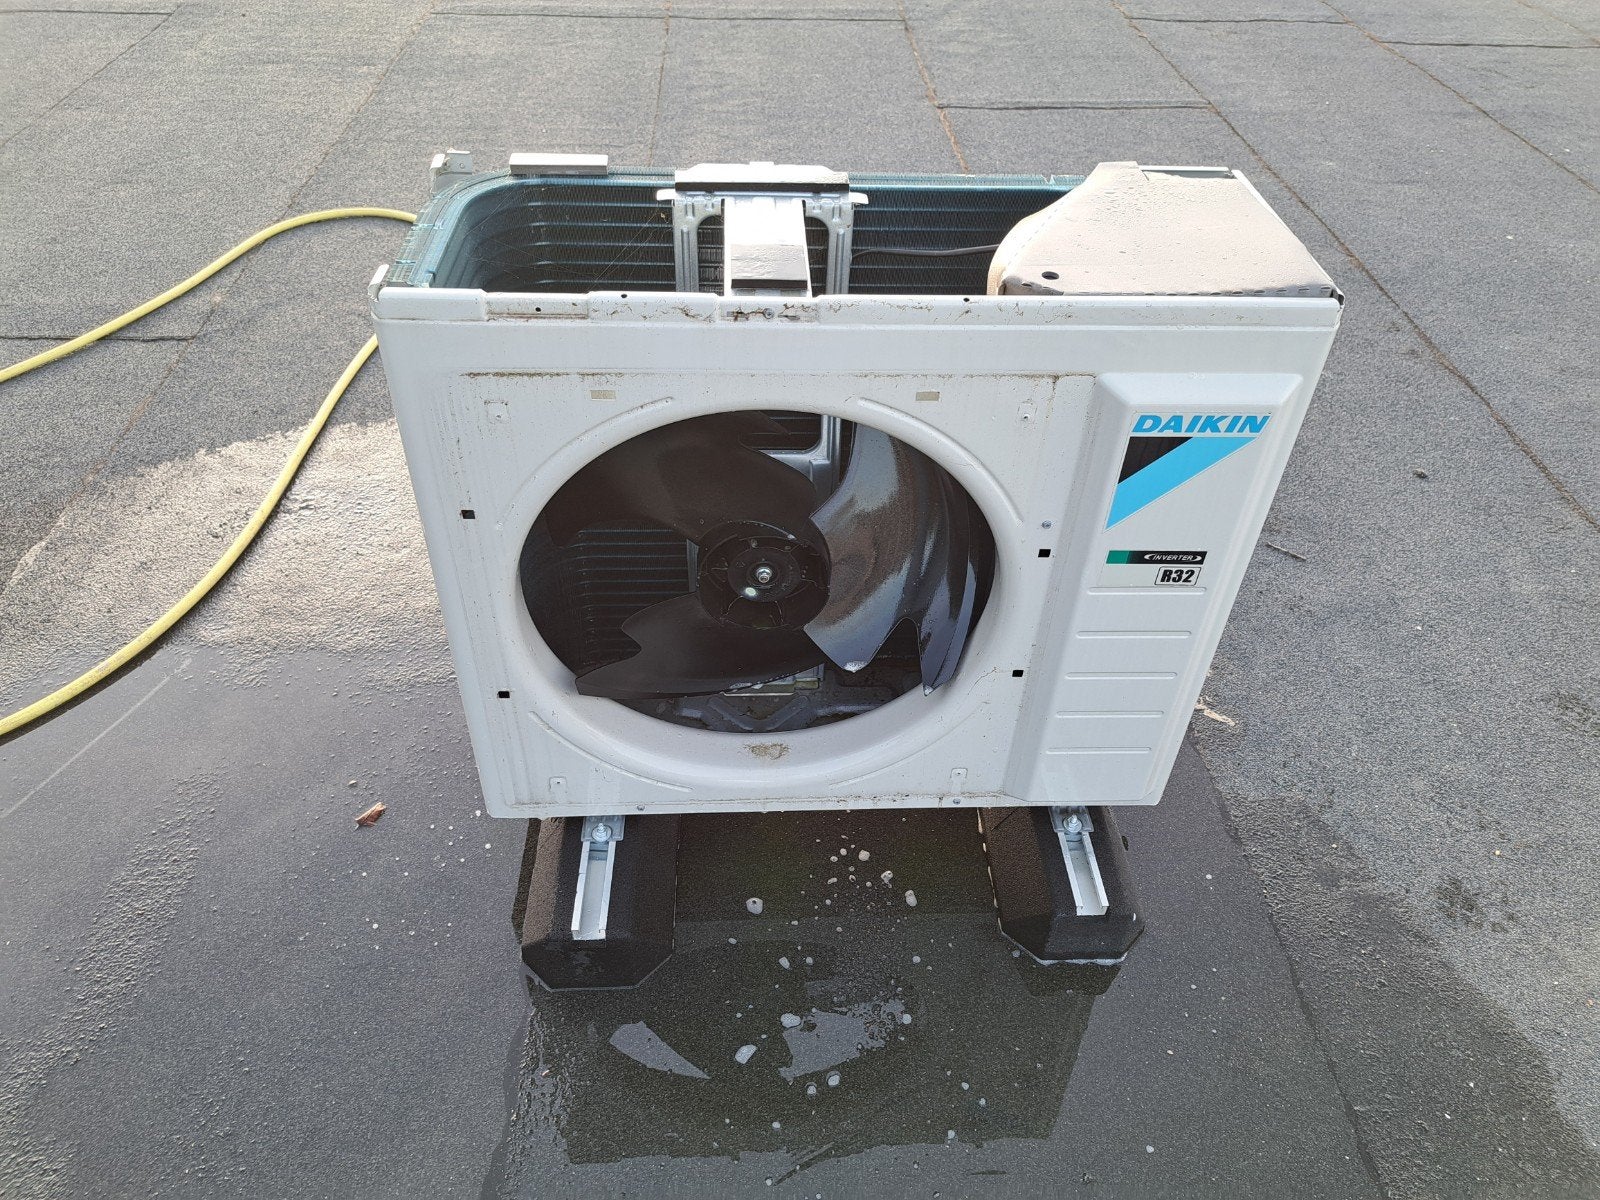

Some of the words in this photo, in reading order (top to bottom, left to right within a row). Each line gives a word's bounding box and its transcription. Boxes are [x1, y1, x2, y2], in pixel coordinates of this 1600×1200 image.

[1131, 415, 1271, 433] DAIKIN
[1153, 553, 1194, 561] INVERTER
[1160, 569, 1196, 583] R32
